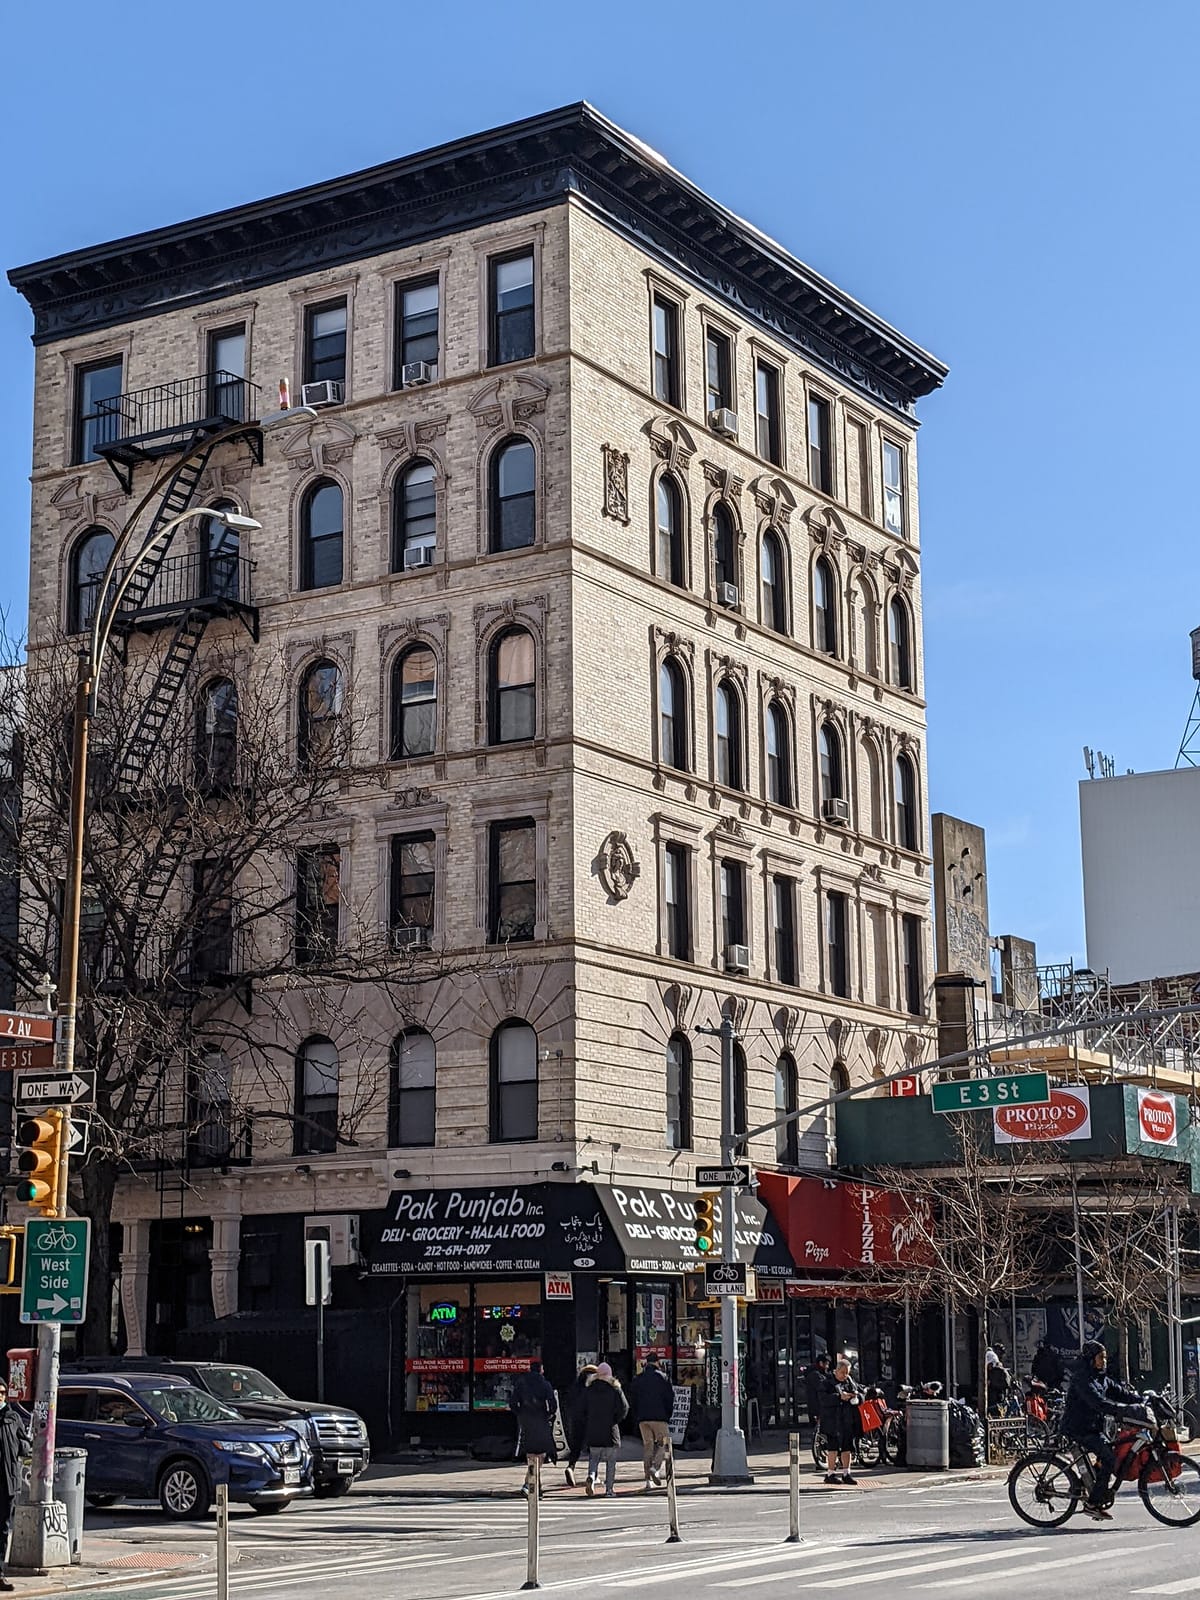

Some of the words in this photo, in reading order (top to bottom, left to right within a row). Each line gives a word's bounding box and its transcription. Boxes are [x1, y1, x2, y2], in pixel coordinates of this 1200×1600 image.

[7, 1018, 14, 1034] 2
[18, 1019, 31, 1036] Av
[1, 1051, 7, 1067] E
[11, 1051, 17, 1067] 3
[21, 1050, 32, 1066] St
[27, 1084, 49, 1097] ONE
[59, 1082, 82, 1095] WAY
[960, 1086, 971, 1103] E
[979, 1084, 990, 1102] 3
[997, 1081, 1020, 1100] St
[1006, 1105, 1077, 1123] PROTO'S
[1143, 1108, 1173, 1125] PROTO'S
[703, 1173, 718, 1181] ONE
[725, 1172, 741, 1180] WAY
[395, 1193, 439, 1221] Pak
[444, 1189, 524, 1223] Punjab
[525, 1201, 544, 1216] Inc.
[611, 1189, 662, 1219] Pak
[741, 1211, 761, 1225] Inc.
[381, 1228, 406, 1242] DELI
[511, 1223, 546, 1238] FOOD
[860, 1189, 875, 1264] Pizza
[744, 1231, 774, 1246] FOOD
[424, 1244, 491, 1256] 212-614-0107
[805, 1240, 829, 1262] Pizza
[40, 1257, 71, 1272] West
[371, 1262, 398, 1272] CIGARETTES
[401, 1262, 414, 1271] SODA
[418, 1261, 433, 1271] CANDY
[463, 1260, 492, 1270] SANDWICHES
[495, 1260, 513, 1269] COFFEE
[523, 1259, 540, 1269] CREAM
[630, 1259, 659, 1270] CIGARETTES
[661, 1261, 676, 1270] SODA
[678, 1261, 695, 1271] CANDY
[40, 1275, 70, 1289] Side
[547, 1281, 571, 1294] ATM
[707, 1284, 723, 1293] BIKE
[726, 1284, 744, 1293] LANE
[431, 1307, 456, 1320] ATM
